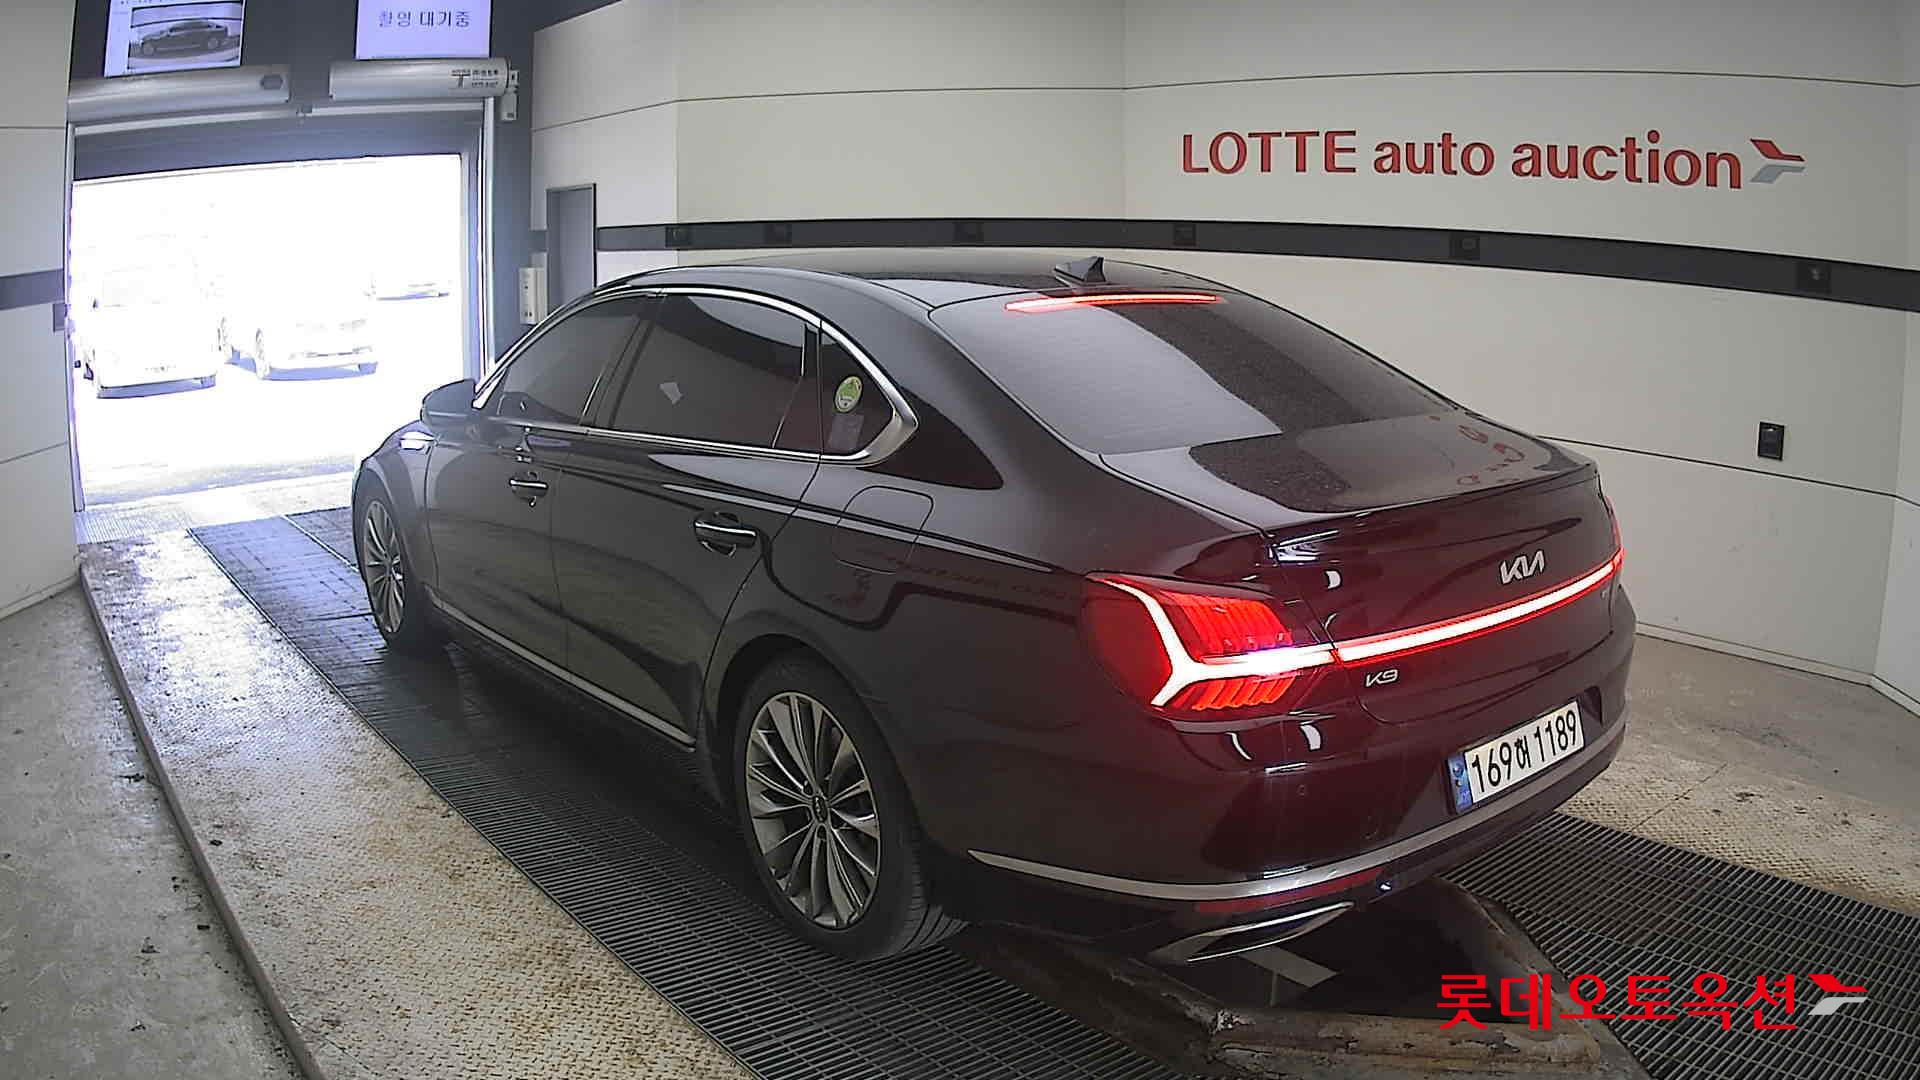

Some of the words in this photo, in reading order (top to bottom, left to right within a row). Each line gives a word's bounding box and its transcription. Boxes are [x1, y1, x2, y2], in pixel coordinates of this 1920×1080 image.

[420, 10, 471, 28] 대기중
[1182, 130, 1357, 175] LOTTE
[1373, 132, 1495, 176] auto
[1511, 129, 1742, 189] auction
[1365, 668, 1399, 688] K9
[1471, 735, 1532, 793] 169허
[1533, 709, 1577, 763] 1189
